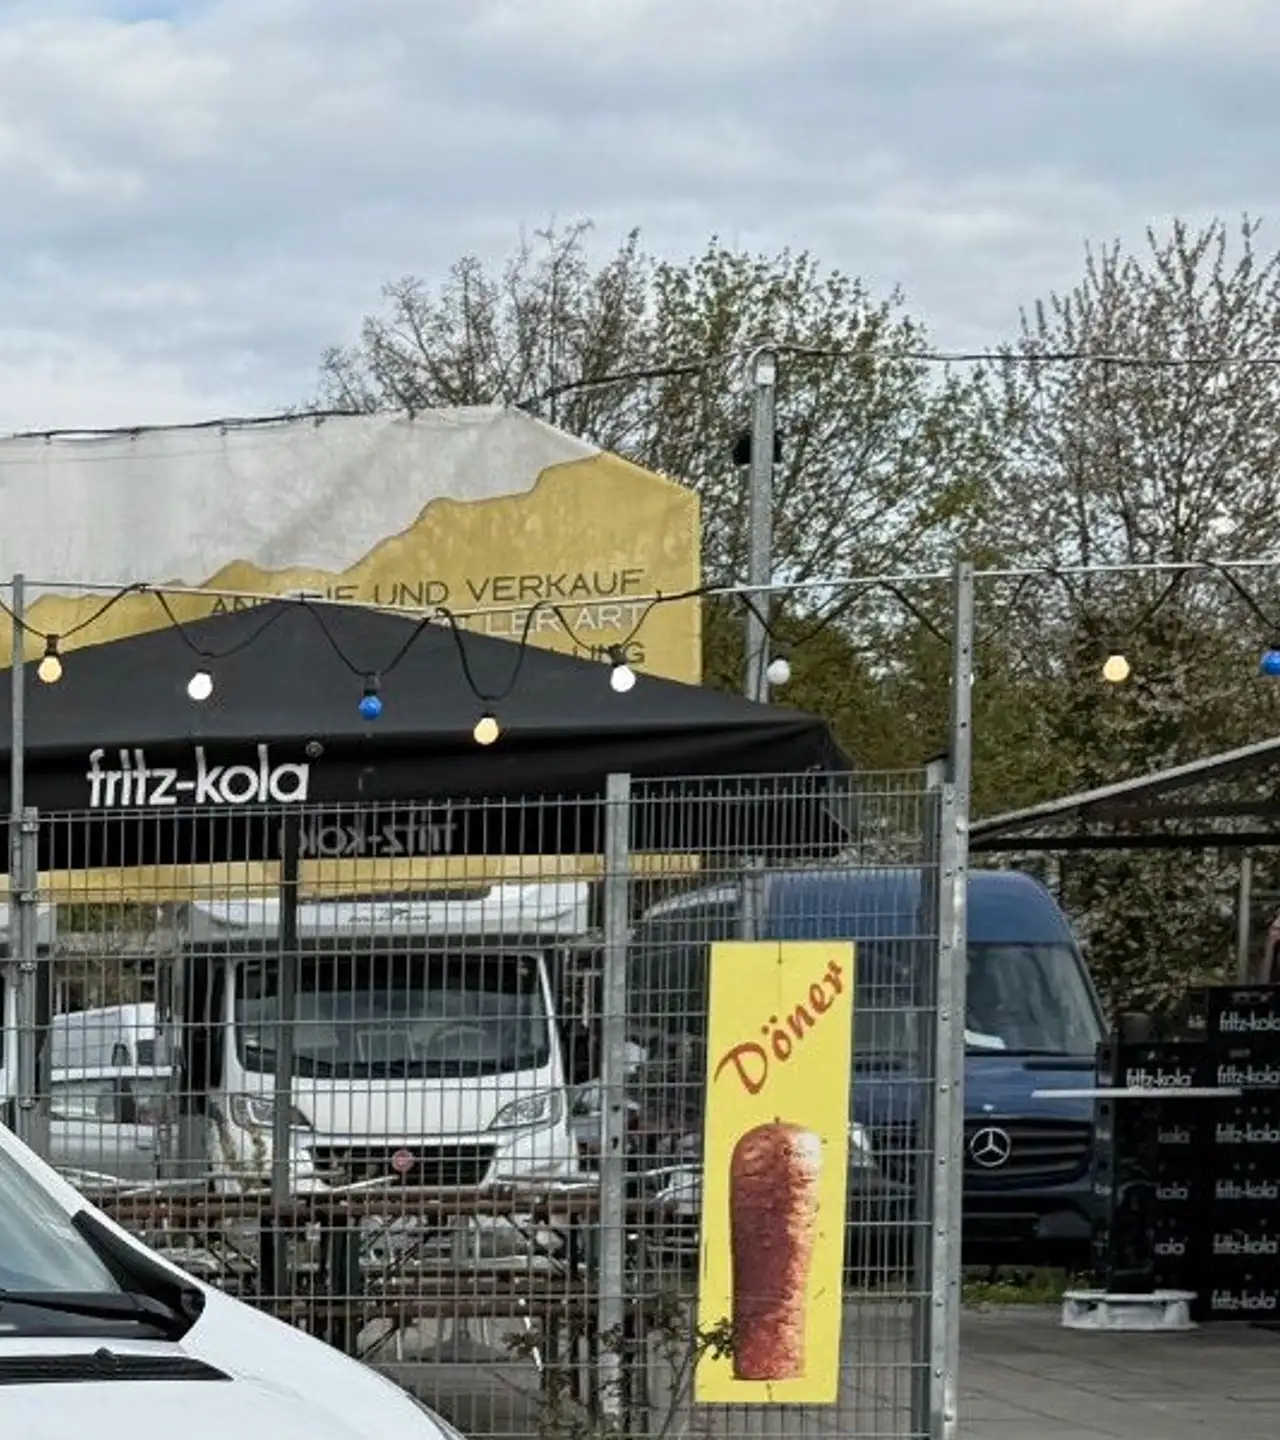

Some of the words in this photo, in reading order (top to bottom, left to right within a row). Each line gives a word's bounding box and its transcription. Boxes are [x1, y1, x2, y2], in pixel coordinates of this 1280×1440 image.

[374, 580, 450, 607] UND
[466, 569, 646, 602] VERKAUF
[574, 604, 646, 632] ART
[86, 743, 309, 808] fritz-kola
[713, 958, 845, 1097] Döner
